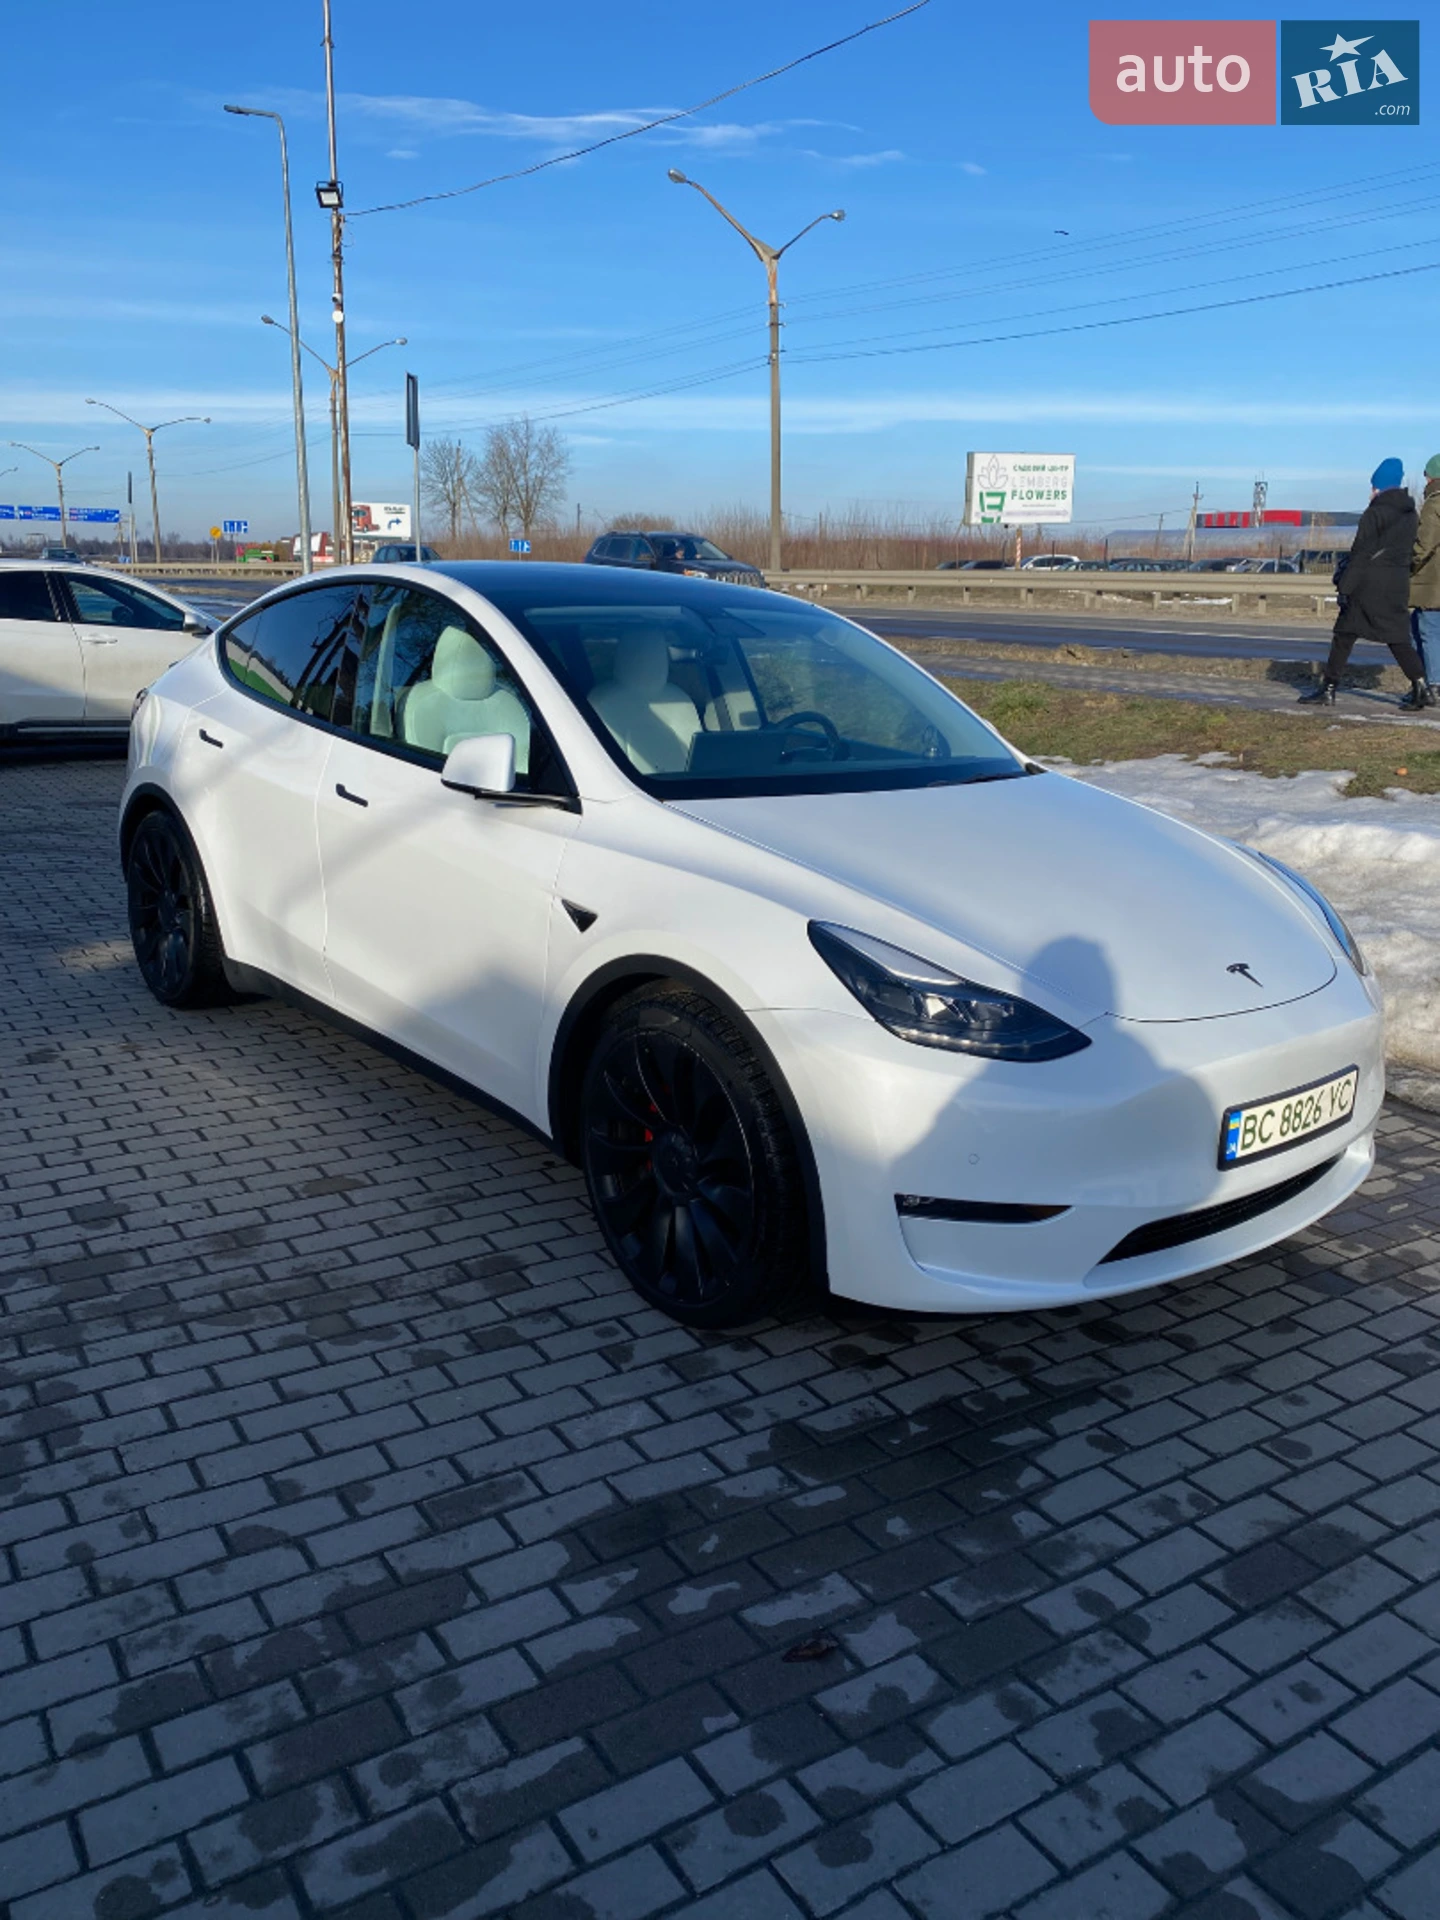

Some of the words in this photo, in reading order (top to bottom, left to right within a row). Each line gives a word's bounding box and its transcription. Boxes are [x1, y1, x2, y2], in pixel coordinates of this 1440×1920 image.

[1011, 489, 1068, 500] FLOWERS
[1240, 1109, 1275, 1150] BC
[1279, 1090, 1325, 1137] 8826
[1329, 1079, 1352, 1117] YC
